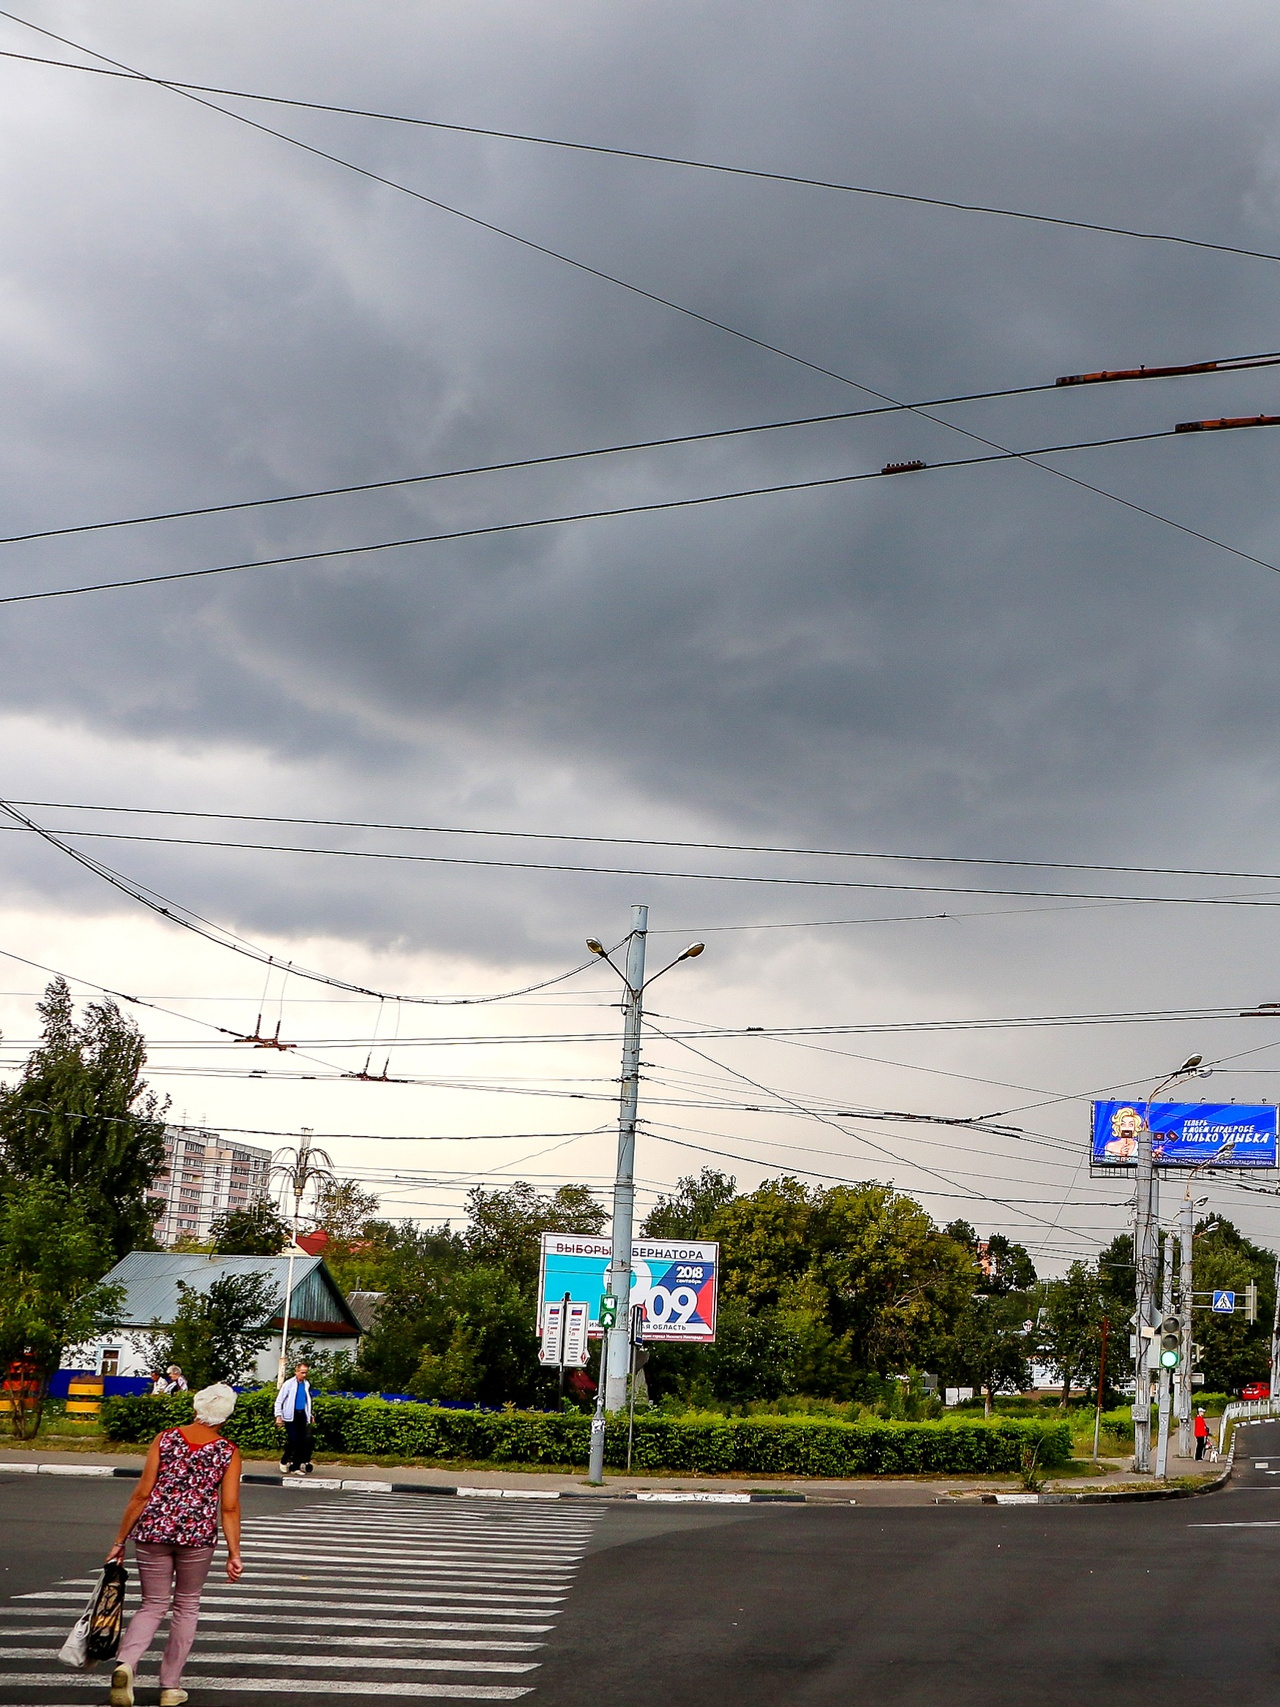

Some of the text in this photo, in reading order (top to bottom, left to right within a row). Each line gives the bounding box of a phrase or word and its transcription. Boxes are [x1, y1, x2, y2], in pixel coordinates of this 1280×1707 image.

[1211, 1125, 1255, 1134] ГАРДЕРОБЕ
[1181, 1132, 1269, 1144] ТОЛЬКО УЛЫБКА
[556, 1243, 704, 1260] ВЫБОРЫ БЕРНАТОРА
[676, 1265, 703, 1279] 2018
[652, 1323, 687, 1331] ОБЛАСТЬ
